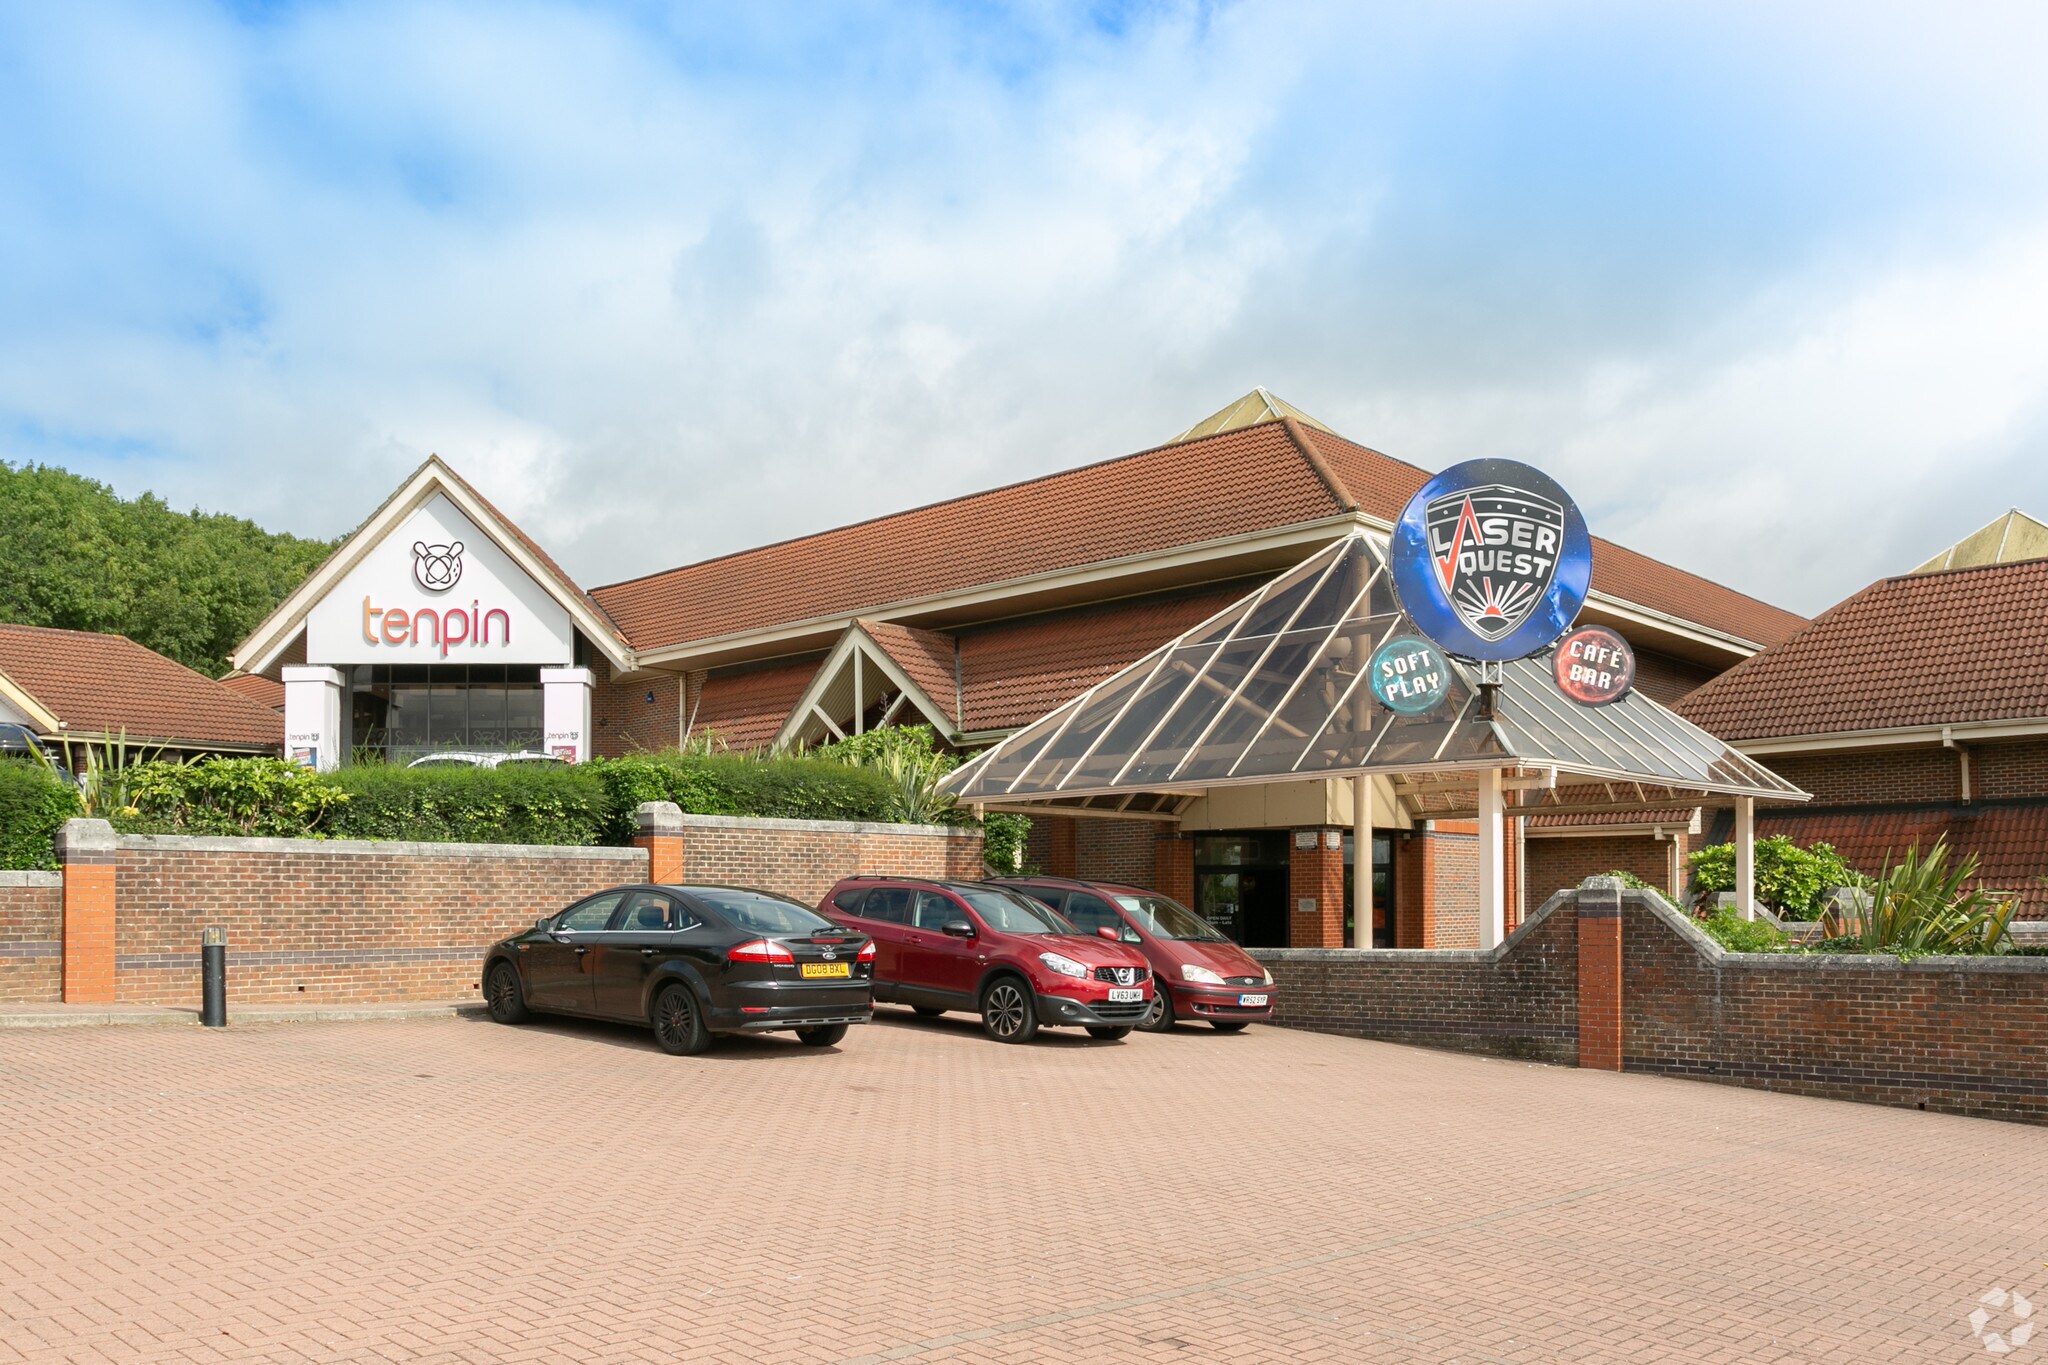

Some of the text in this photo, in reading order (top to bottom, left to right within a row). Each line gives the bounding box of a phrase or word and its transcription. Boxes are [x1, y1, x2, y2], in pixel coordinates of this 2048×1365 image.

[1431, 494, 1556, 555] LASER
[1460, 549, 1552, 578] QUEST
[363, 594, 511, 656] tenpin
[1381, 650, 1430, 678] SOFT
[1569, 640, 1622, 668] CAFÉ
[1385, 672, 1438, 702] PLAY
[1569, 664, 1611, 689] BAR
[289, 733, 310, 742] tenpin
[547, 732, 570, 741] tenpin
[806, 964, 828, 975] DG08
[829, 963, 846, 974] BXL
